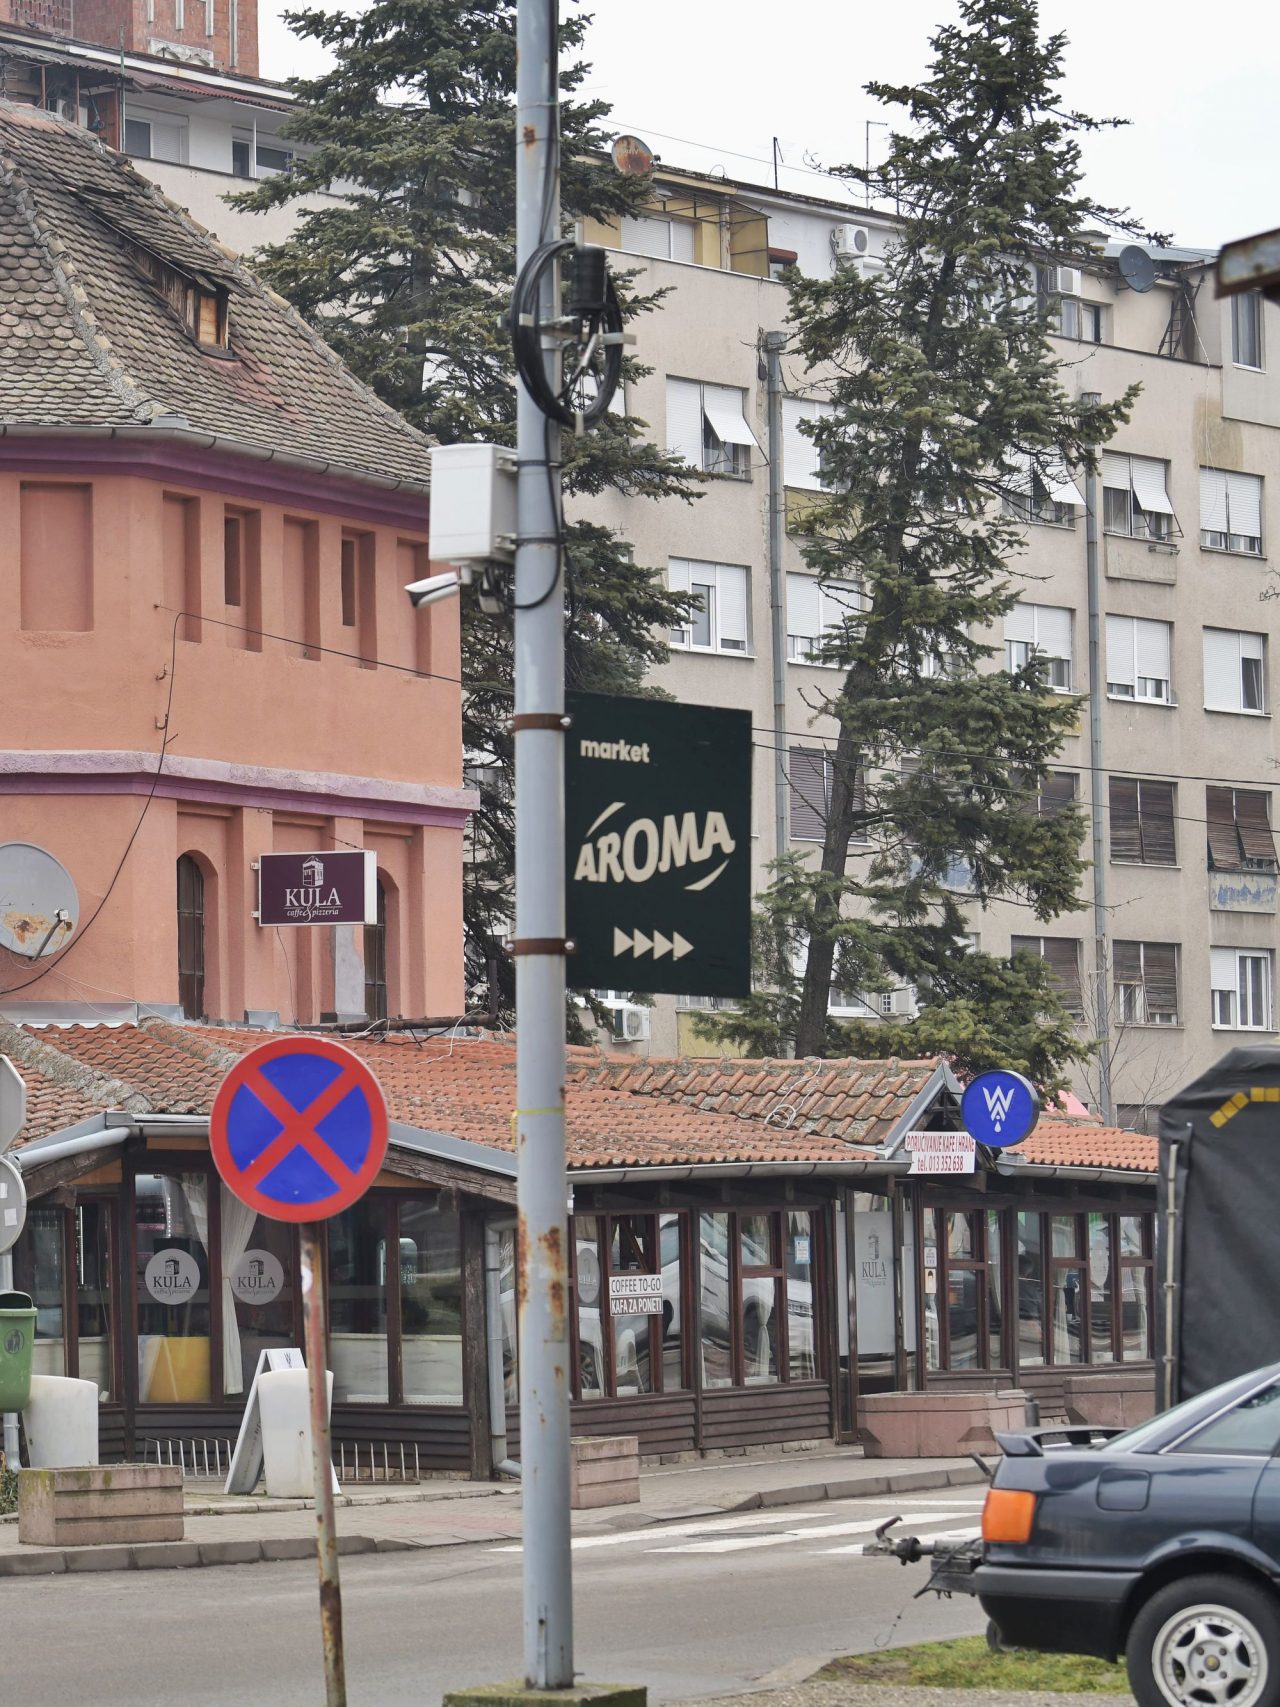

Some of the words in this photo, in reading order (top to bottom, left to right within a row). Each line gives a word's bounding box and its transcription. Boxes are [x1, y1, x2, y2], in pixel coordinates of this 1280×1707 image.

[580, 739, 650, 763] market
[574, 811, 736, 883] AROMA
[285, 887, 342, 907] KULA
[287, 908, 303, 918] caffe
[303, 904, 317, 922] &
[312, 908, 339, 917] pizzeria
[943, 1136, 955, 1152] KAFE
[918, 1155, 928, 1171] tel.
[929, 1155, 940, 1171] 013
[941, 1155, 952, 1171] 352
[953, 1155, 964, 1171] 638
[862, 1261, 887, 1278] KULA
[153, 1276, 192, 1288] KULA
[237, 1276, 276, 1288] KULA
[611, 1279, 637, 1293] COFFEE
[639, 1278, 661, 1291] TO-GO
[611, 1299, 628, 1314] KAFA
[629, 1299, 637, 1312] ZA
[638, 1297, 662, 1312] PONETI
